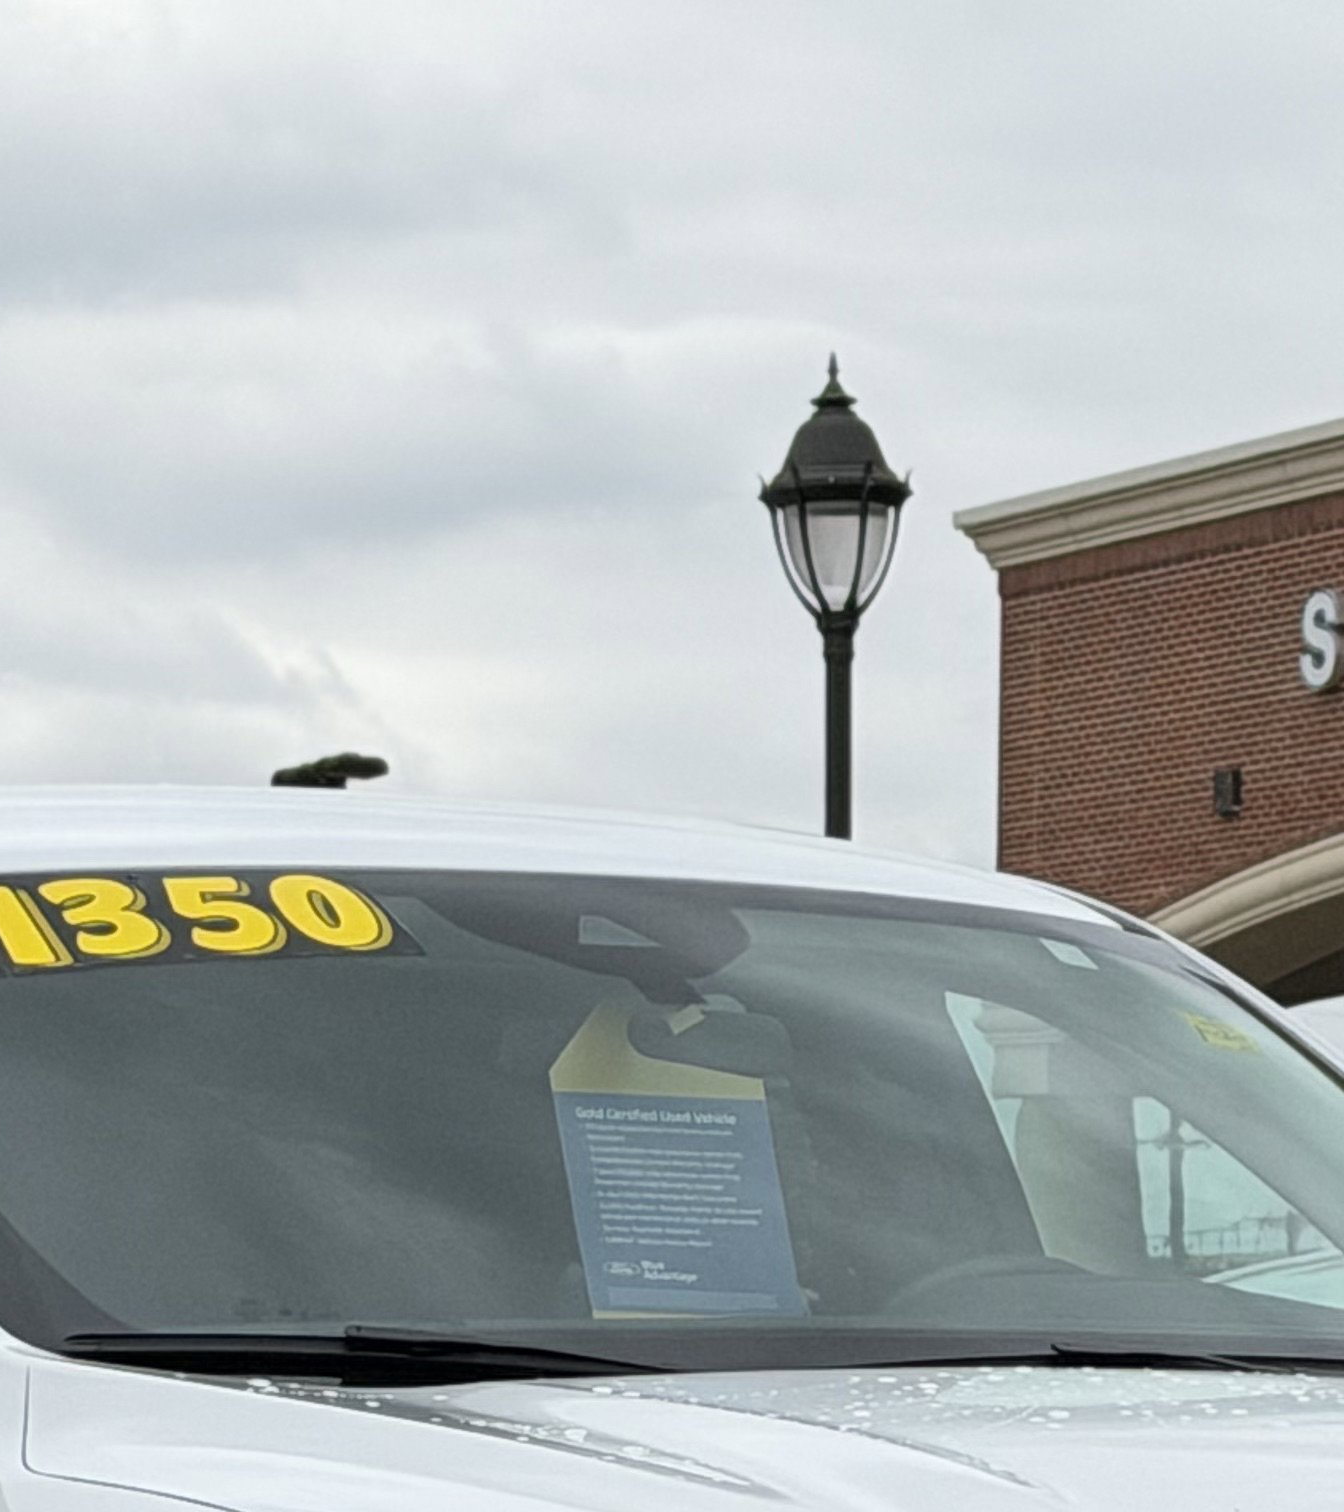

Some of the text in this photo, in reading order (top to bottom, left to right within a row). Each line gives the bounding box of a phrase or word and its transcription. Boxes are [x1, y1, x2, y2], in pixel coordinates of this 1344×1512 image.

[575, 1106, 737, 1125] Gold Certified Used Vehicle
[644, 1270, 698, 1284] Advantage
